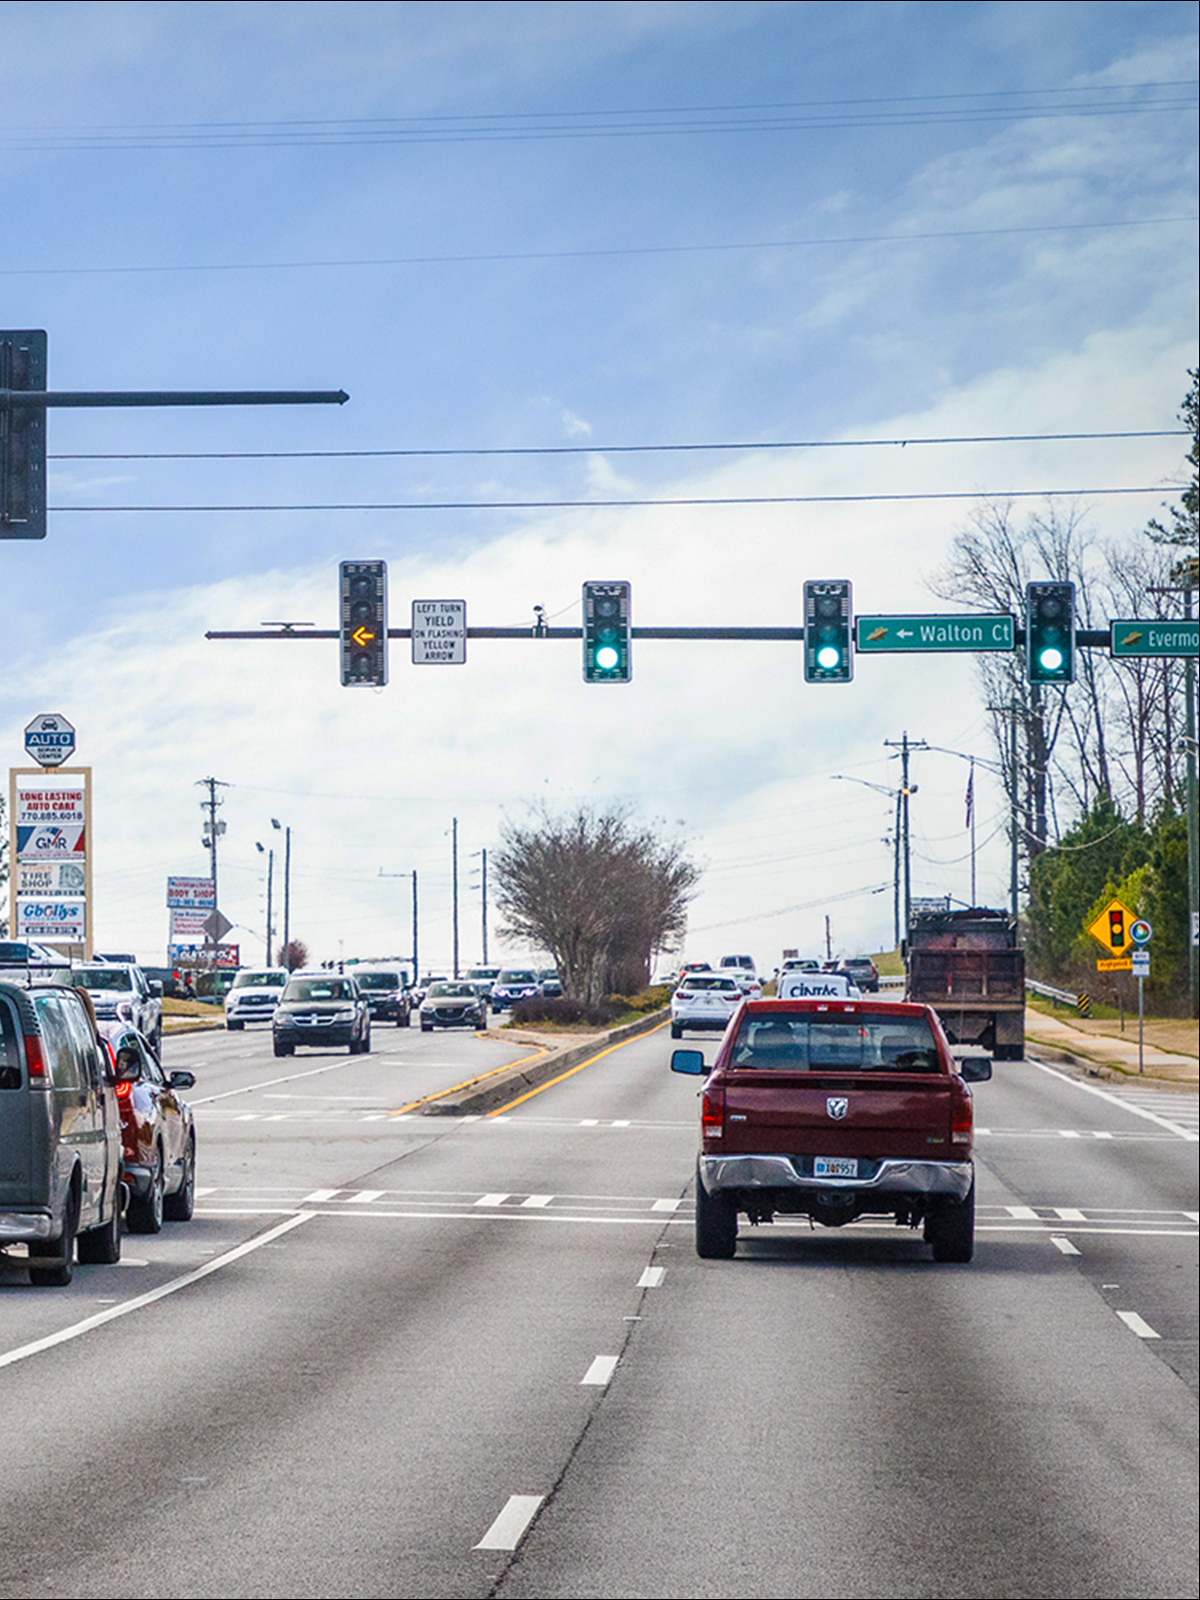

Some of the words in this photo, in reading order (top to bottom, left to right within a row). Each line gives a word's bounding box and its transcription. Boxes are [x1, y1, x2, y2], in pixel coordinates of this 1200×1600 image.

[416, 604, 436, 613] LEFT
[440, 604, 461, 613] TURN
[425, 616, 454, 627] YIELD
[415, 630, 425, 638] ON
[428, 630, 464, 638] FLASHING
[920, 623, 983, 642] Walton
[992, 623, 1009, 642] Ct
[1149, 630, 1199, 647] Evermo
[423, 641, 455, 650] YELLOW
[424, 652, 453, 660] ARROW
[29, 733, 71, 745] AUTO
[20, 792, 43, 801] LONG
[45, 792, 82, 801] LASTING
[27, 802, 50, 811] AUTO
[52, 802, 75, 811] CARE
[21, 880, 52, 888] SHOP
